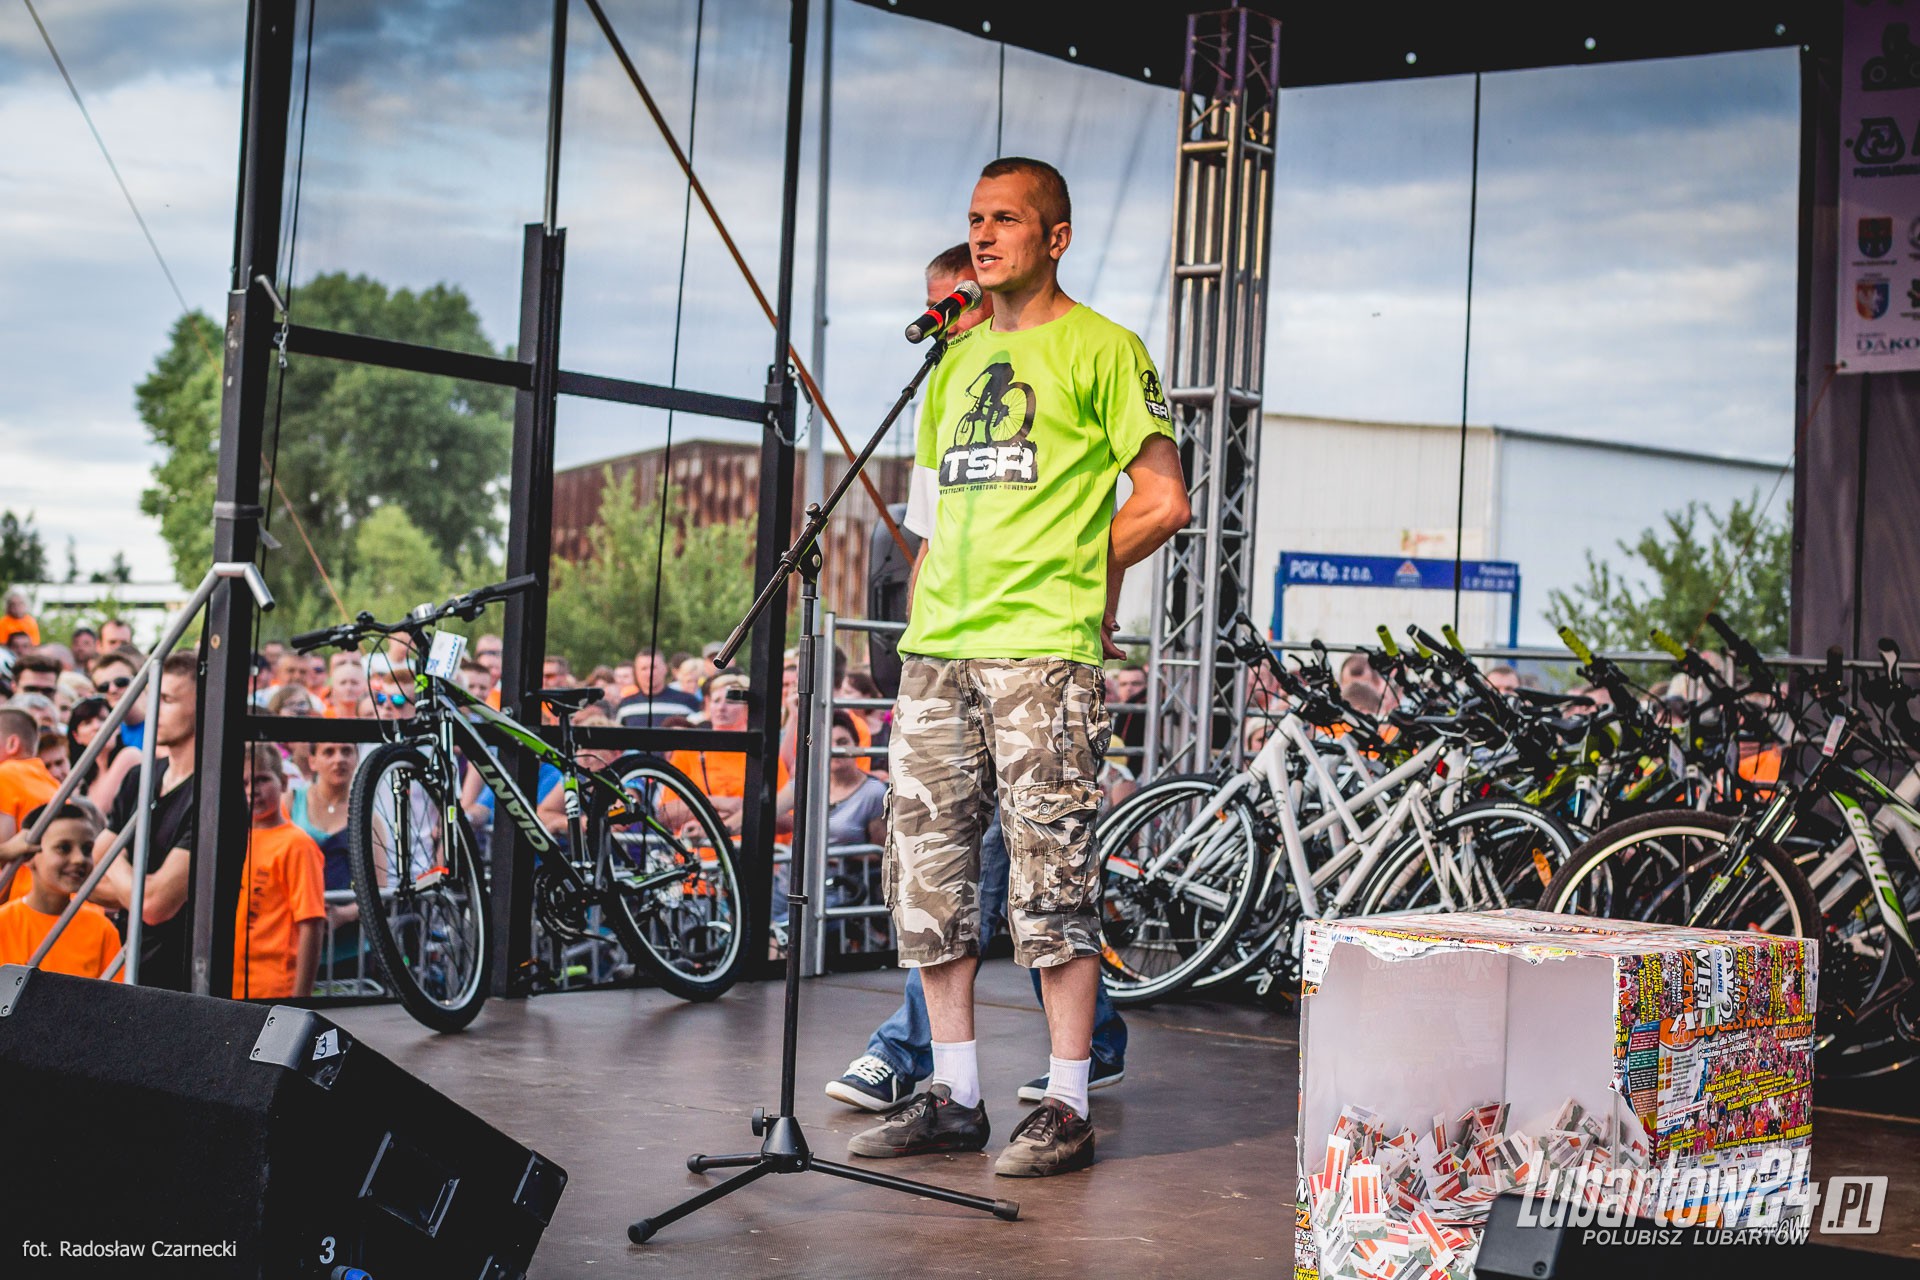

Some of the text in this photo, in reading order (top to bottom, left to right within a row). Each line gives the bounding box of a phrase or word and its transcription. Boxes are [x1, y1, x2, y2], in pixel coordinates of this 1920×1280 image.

[1145, 400, 1169, 419] TSR
[944, 444, 1034, 482] TSR
[1290, 560, 1319, 579] PGK
[1320, 560, 1340, 583] Sp.
[472, 760, 550, 853] GIANT
[1733, 977, 1742, 1010] 2015
[1704, 1083, 1724, 1093] Marcin
[1725, 1075, 1741, 1087] Wójcik
[1714, 1091, 1737, 1103] Zbigniew
[1738, 1084, 1755, 1096] Spruch
[1727, 1101, 1744, 1111] Roman
[1669, 1117, 1685, 1125] GIANT
[319, 1236, 336, 1264] 3
